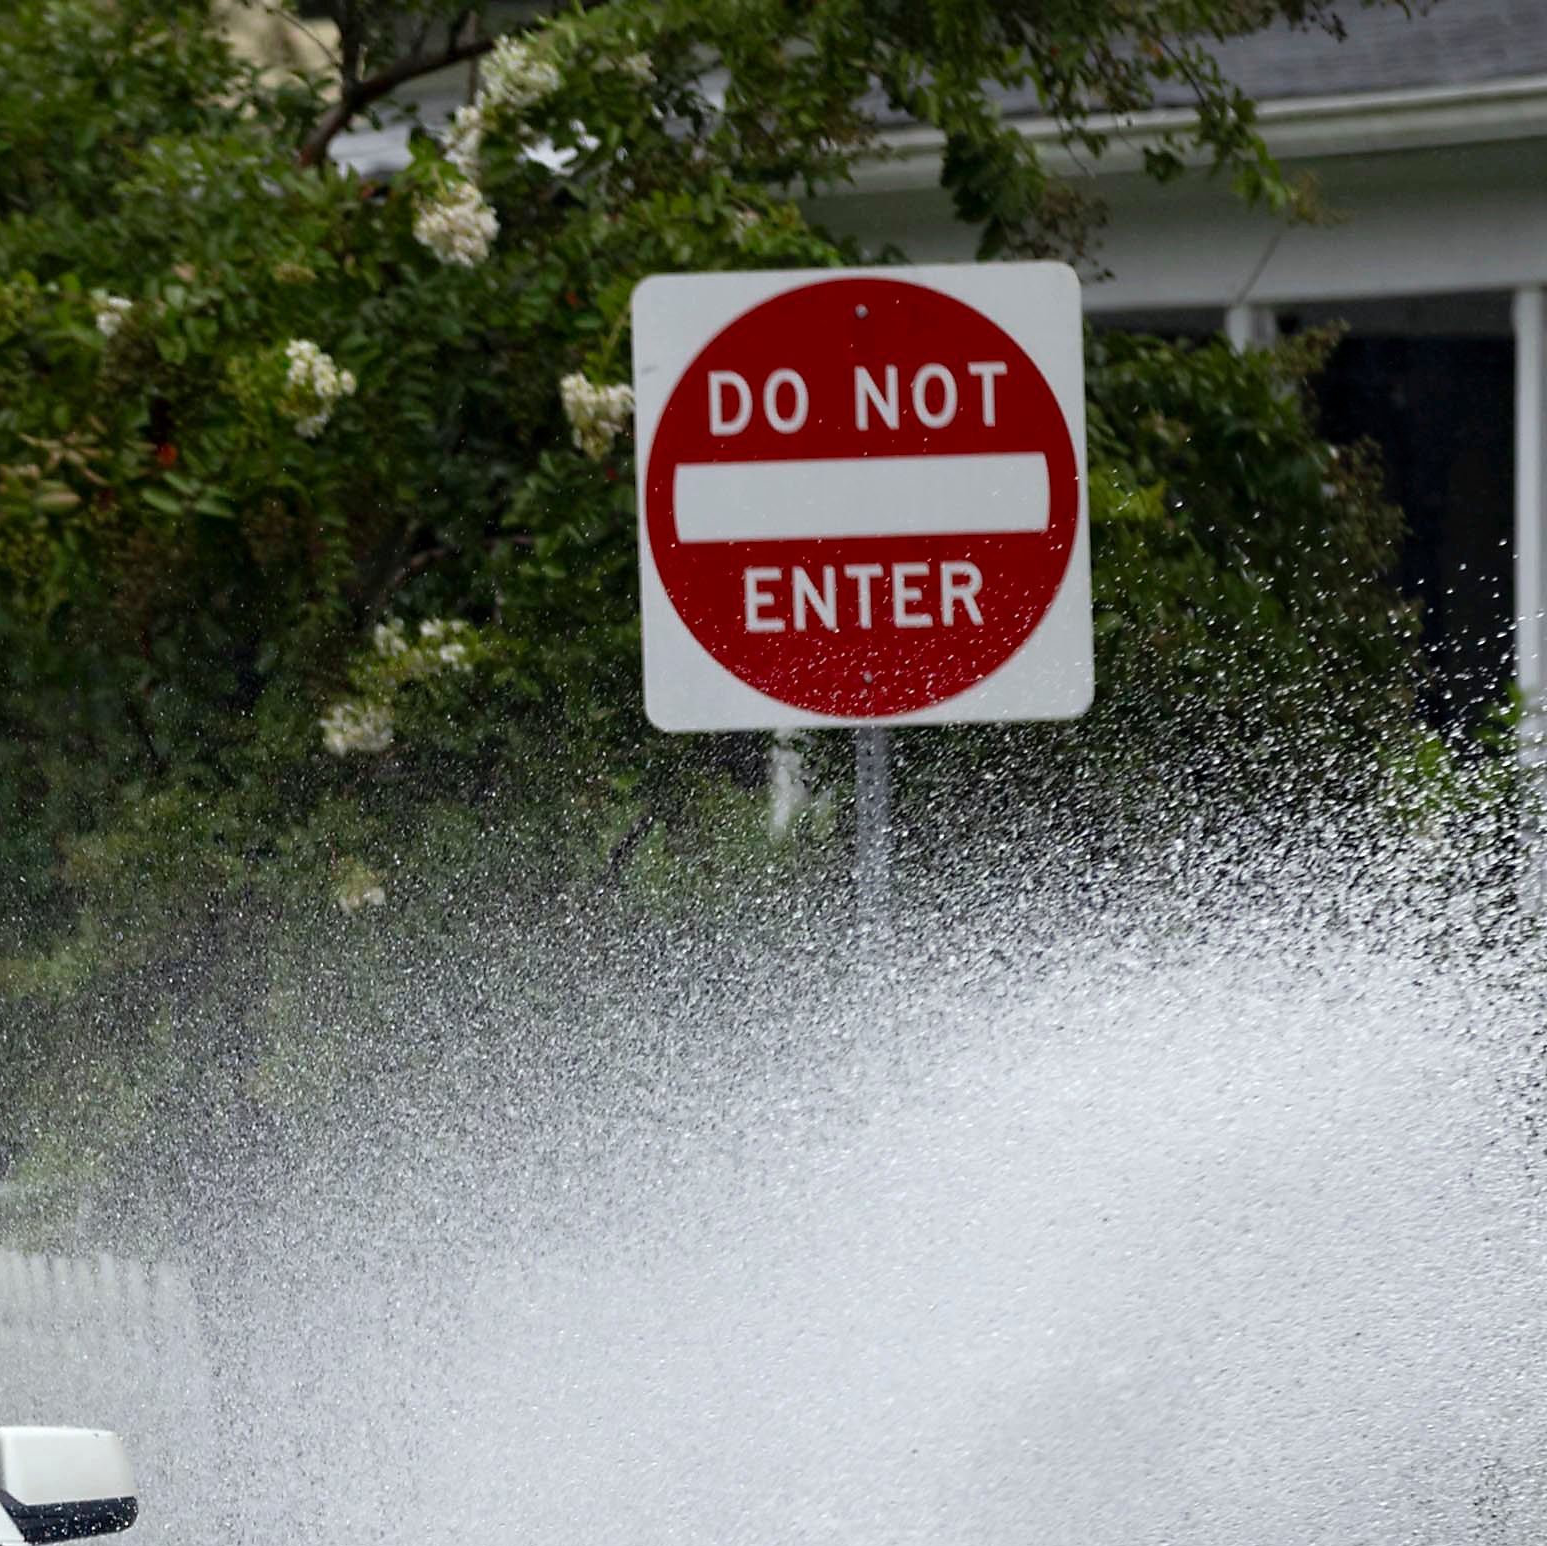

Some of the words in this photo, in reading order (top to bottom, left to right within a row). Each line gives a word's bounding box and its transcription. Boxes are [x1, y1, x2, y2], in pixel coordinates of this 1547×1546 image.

[708, 368, 809, 436] DO
[855, 361, 1008, 430] NOT
[744, 560, 984, 633] ENTER
